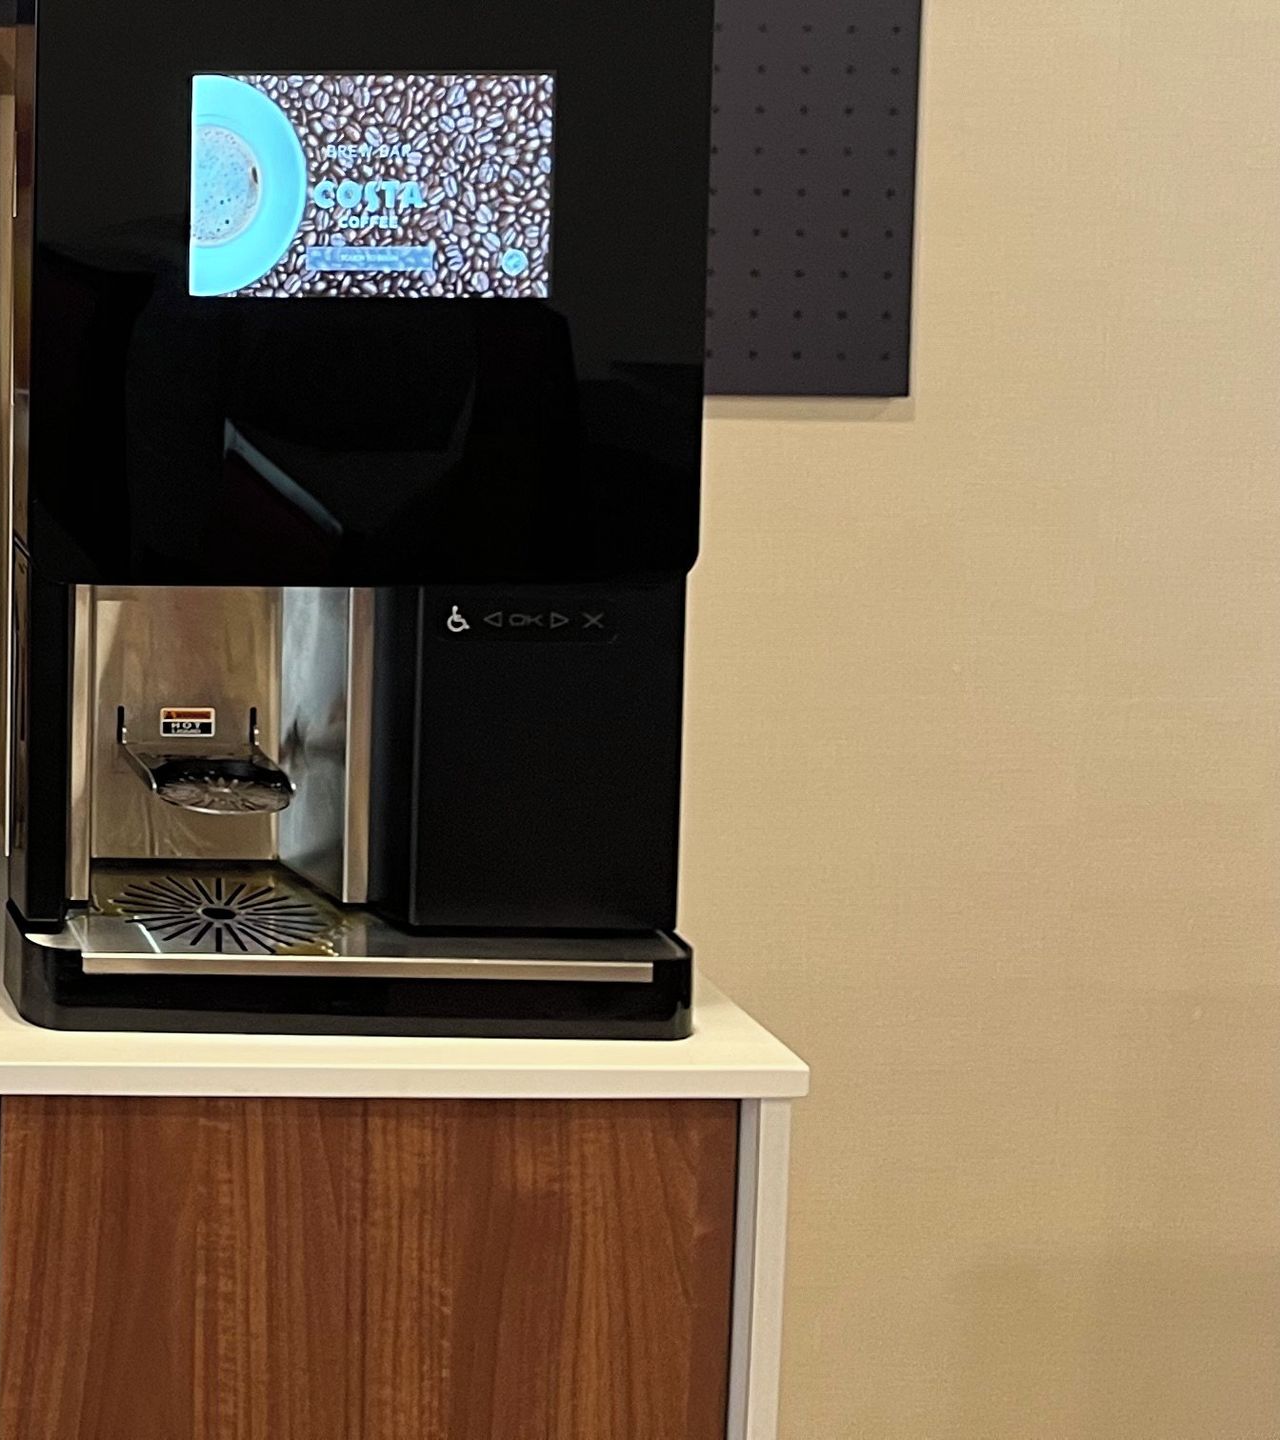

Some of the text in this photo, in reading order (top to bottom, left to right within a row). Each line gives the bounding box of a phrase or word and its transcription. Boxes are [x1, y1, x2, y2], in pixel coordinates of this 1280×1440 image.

[313, 179, 428, 213] COSTA
[337, 215, 399, 229] COFFEE
[508, 612, 544, 627] OK
[171, 721, 201, 730] HOT
